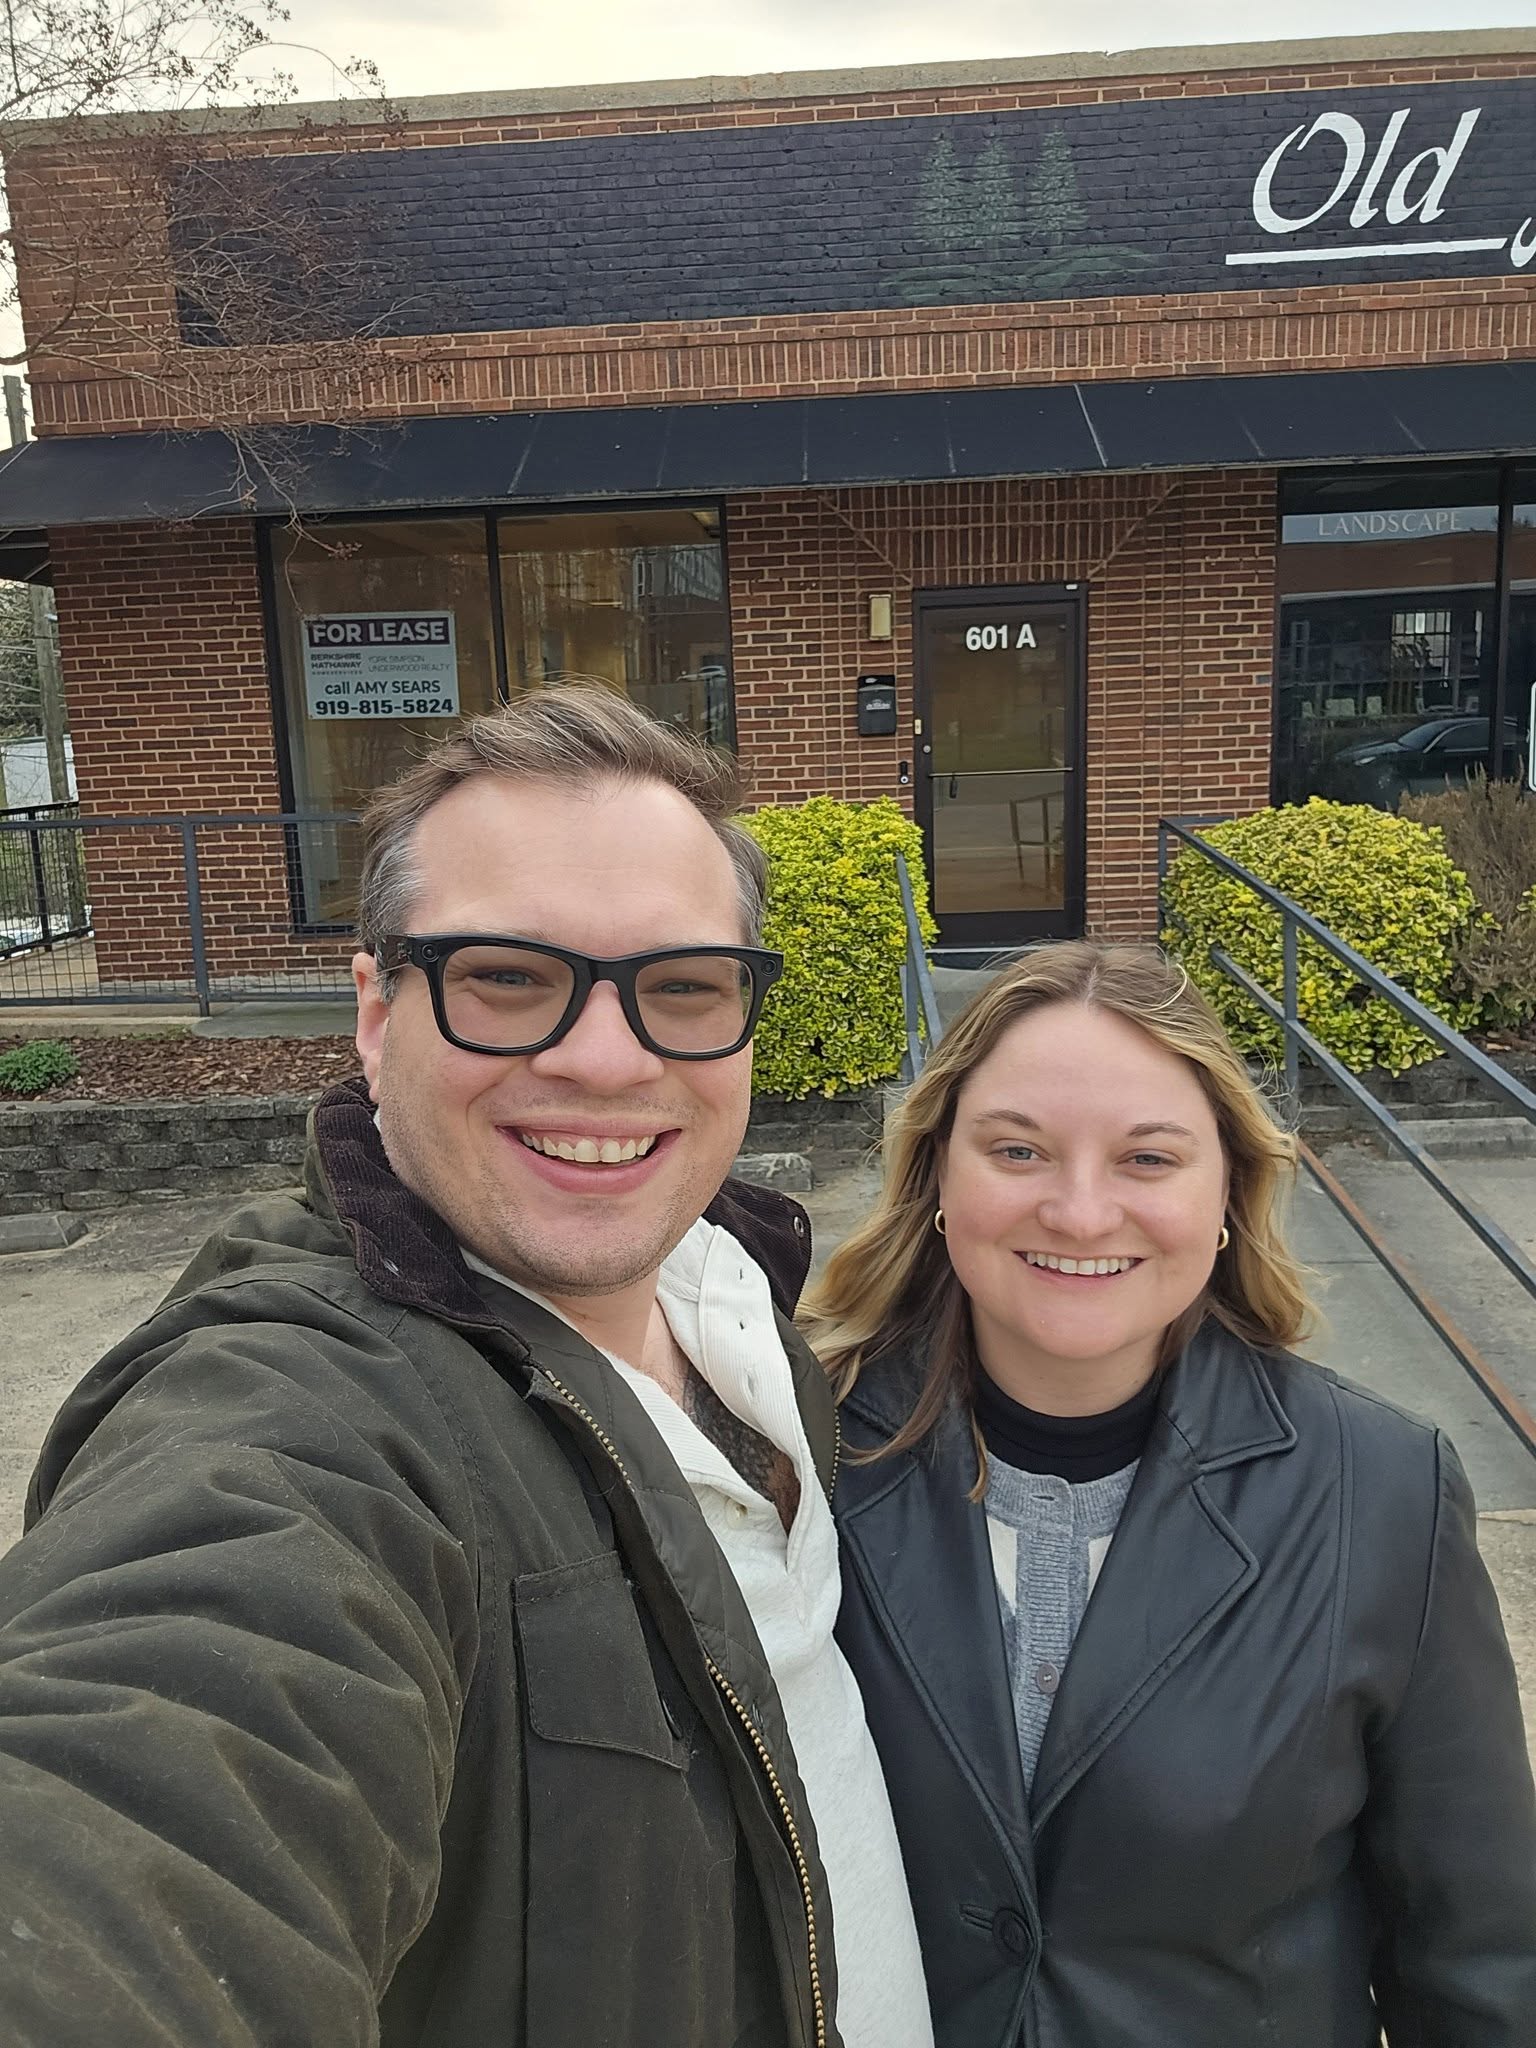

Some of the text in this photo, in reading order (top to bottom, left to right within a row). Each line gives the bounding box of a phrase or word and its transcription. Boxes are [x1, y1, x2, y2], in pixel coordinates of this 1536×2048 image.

[1252, 107, 1482, 234] Old
[1318, 511, 1462, 536] LANDSCAPE
[313, 621, 445, 643] FOR LEASE
[966, 623, 1037, 651] 601 A
[311, 652, 362, 661] BERKSHIRE
[311, 661, 362, 669] HATHAWAY
[325, 680, 441, 695] call AMY SEARS
[315, 698, 454, 716] 919-815-5824
